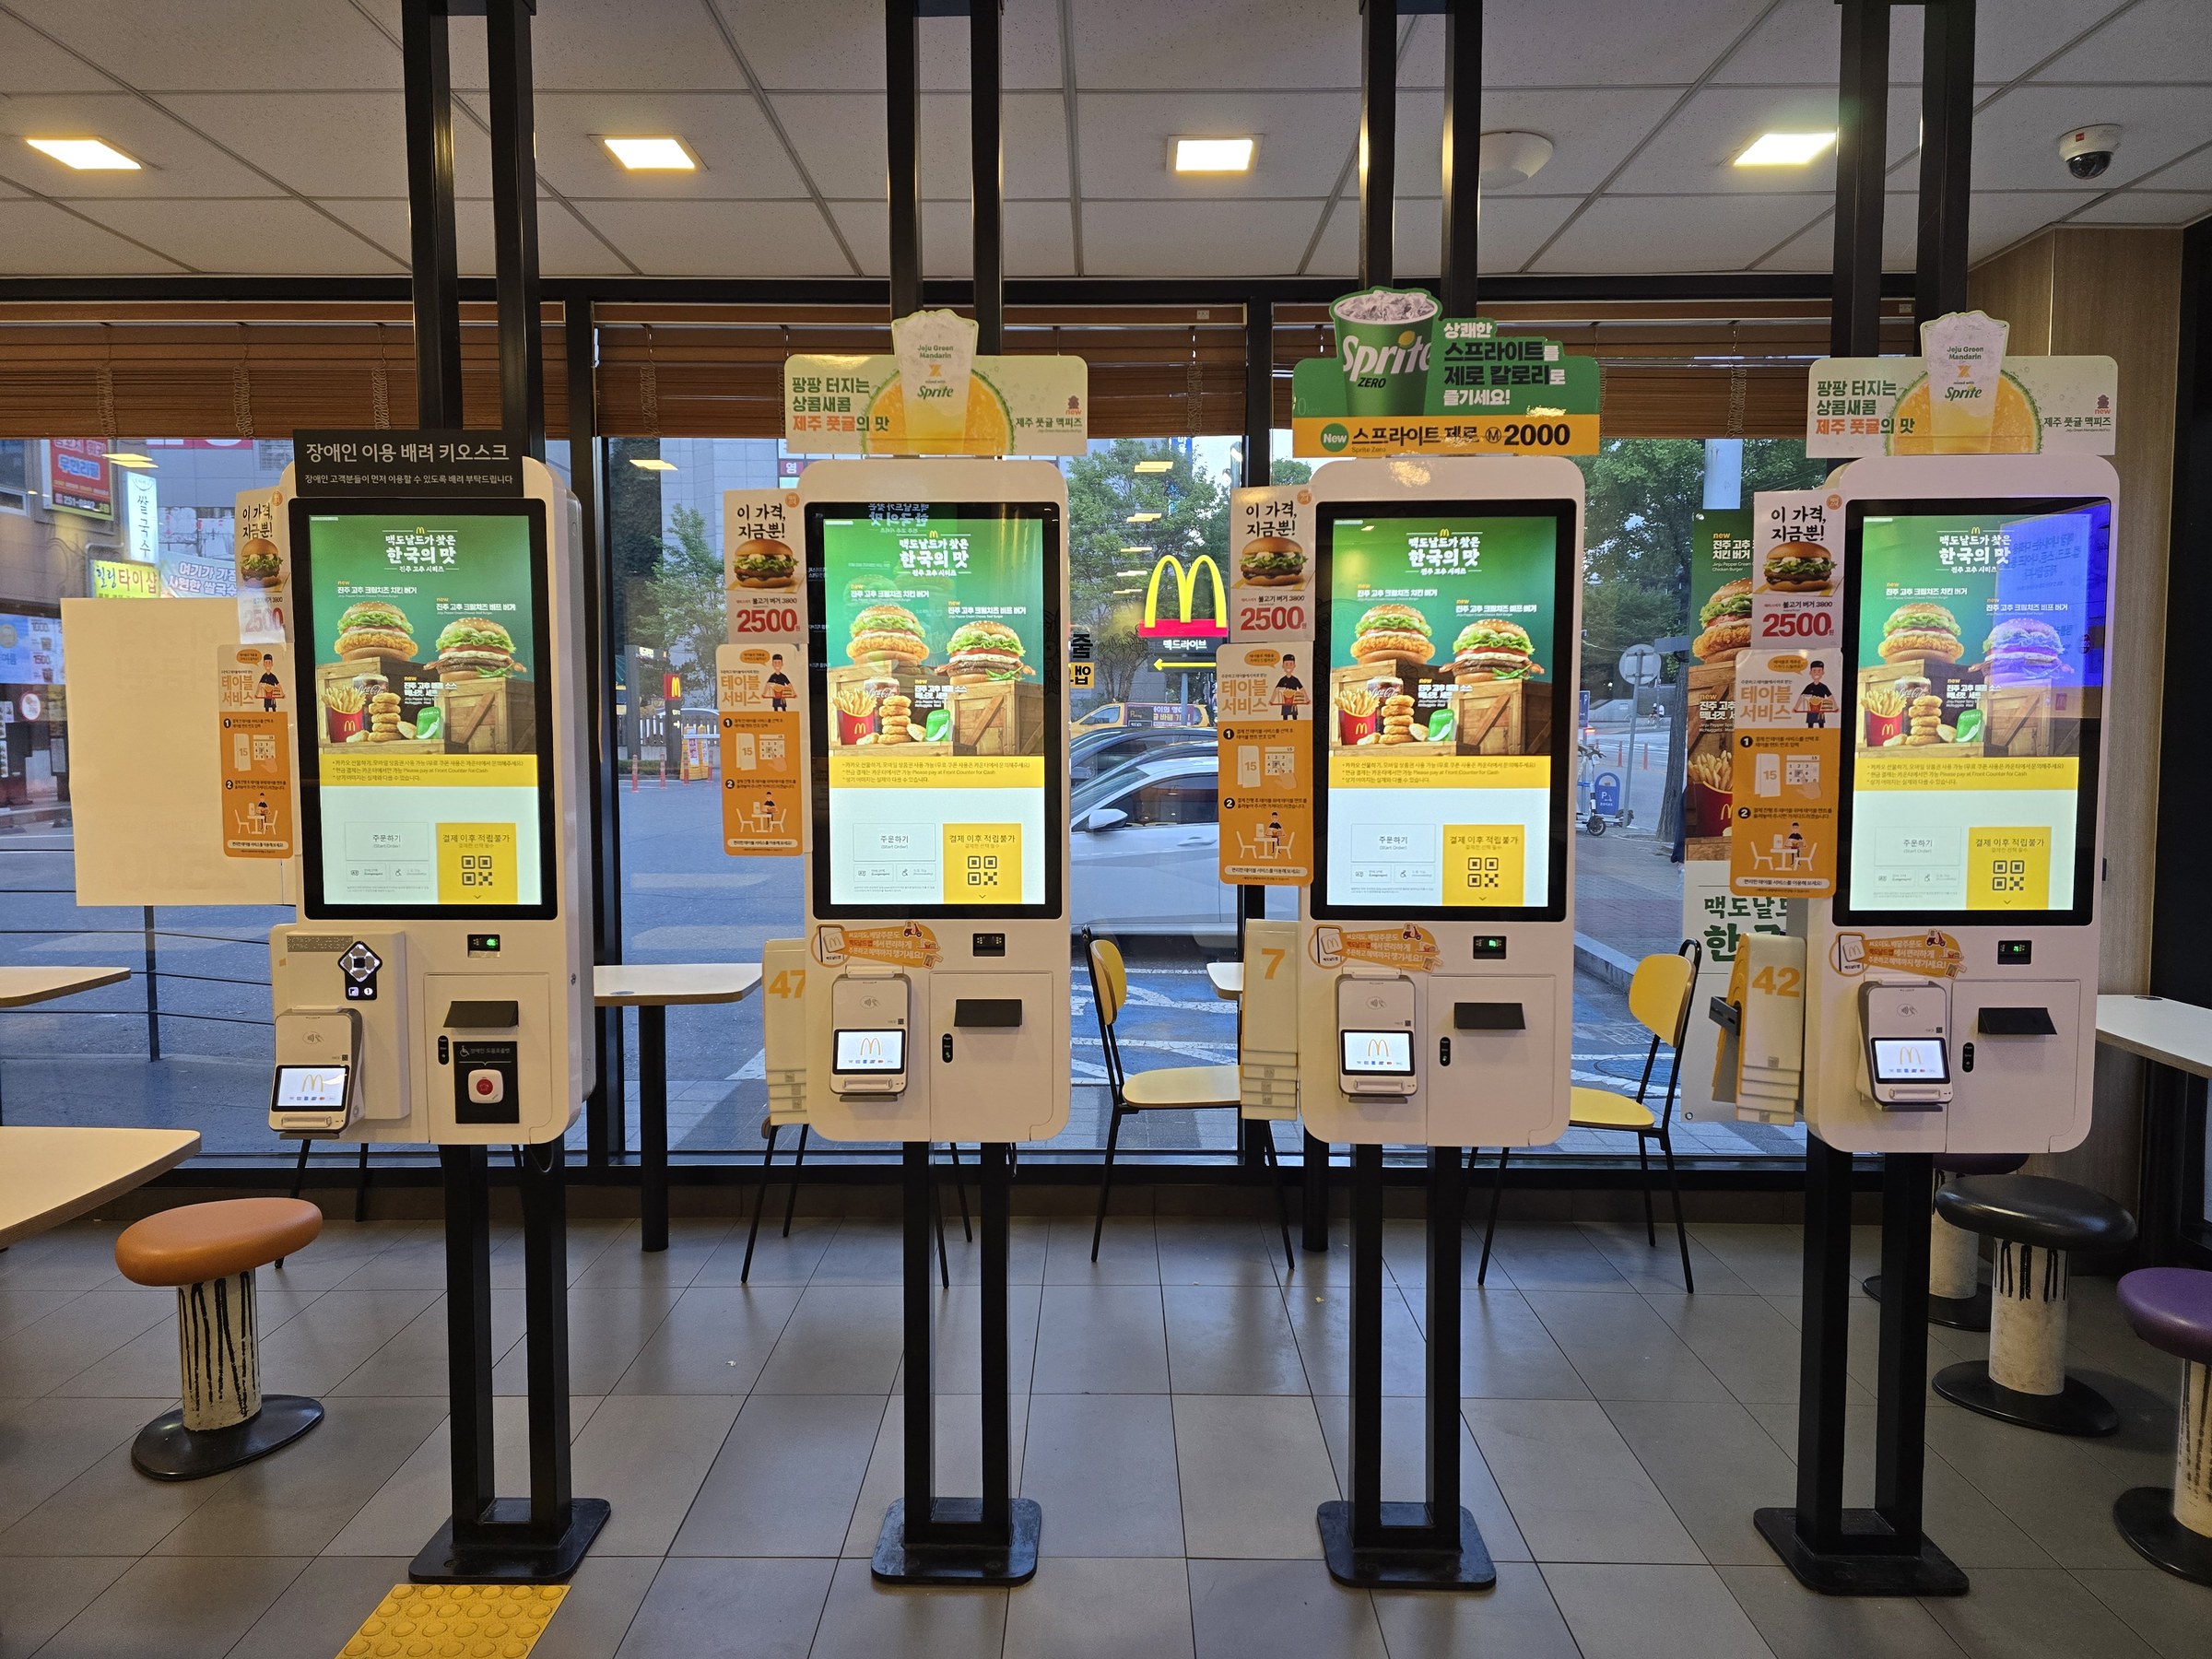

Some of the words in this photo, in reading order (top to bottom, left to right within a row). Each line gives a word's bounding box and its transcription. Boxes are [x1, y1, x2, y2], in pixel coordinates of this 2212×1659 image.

[1443, 323, 1491, 338] 상쾌한
[1343, 335, 1431, 382] Sprite
[1444, 341, 1559, 361] 스프라이트를
[1358, 377, 1386, 388] ZERO
[1444, 365, 1485, 385] 제로
[1490, 365, 1566, 385] 칼로리로
[793, 377, 821, 393] 팡팡
[827, 377, 869, 394] 터지는
[917, 385, 953, 400] Sprite
[1818, 381, 1847, 396] 팡팡
[1852, 381, 1896, 396] 터지는
[1443, 389, 1510, 406] 즐기세요!
[1945, 387, 1982, 401] Sprite
[793, 397, 851, 412] 상콤새콤
[1817, 399, 1876, 415] 상콤새콤
[794, 416, 821, 431] 제주
[827, 416, 869, 431] 풋귤의
[875, 416, 888, 431] 맛
[1016, 418, 1032, 428] 제주
[1036, 418, 1053, 428] 풋귤
[1056, 418, 1082, 427] 맥피즈
[1816, 418, 1845, 434] 제주
[1850, 418, 1894, 434] 풋귤의
[1900, 418, 1914, 434] 맛
[2043, 418, 2061, 427] 제주
[2065, 418, 2082, 427] 풋귤
[2085, 418, 2112, 427] 맥피즈
[1323, 433, 1347, 443] New
[1351, 427, 1440, 446] 스프라이트
[1445, 427, 1479, 443] 제로
[1504, 424, 1570, 446] 2000
[306, 444, 357, 463] 장애인
[362, 444, 396, 463] 이용
[401, 444, 433, 463] 배려
[440, 444, 509, 463] 키오스크
[305, 475, 328, 484] 장애인
[330, 475, 370, 484] 고객분들이
[371, 475, 386, 484] 먼저
[388, 475, 412, 484] 이용할
[414, 475, 421, 484] 수
[424, 475, 446, 484] 있도록
[449, 475, 464, 484] 배려
[465, 475, 512, 484] 부탁드립니다
[242, 505, 250, 521] 이
[737, 504, 749, 521] 이
[756, 503, 785, 521] 가격,
[1246, 502, 1259, 519] 이
[1266, 500, 1297, 519] 가격,
[1771, 507, 1785, 524] 이
[1792, 506, 1826, 524] 가격,
[137, 496, 150, 558] 쌀국수
[242, 522, 272, 540] 지금뿐!
[738, 523, 785, 539] 지금뿐!
[1246, 521, 1295, 537] 지금뿐!
[1771, 525, 1824, 542] 지금뿐!
[385, 535, 434, 546] 맥도날드가
[900, 538, 947, 550] 맥도날드가
[1408, 537, 1458, 548] 맥도날드가
[1713, 540, 1731, 549] 진주
[1733, 540, 1750, 549] 고추
[1939, 535, 1990, 547] 맥도날드가
[386, 547, 436, 564] 한국의
[440, 547, 456, 564] 맛
[900, 550, 948, 568] 한국의
[953, 550, 969, 569] 맛
[1408, 549, 1458, 567] 한국의
[1464, 548, 1480, 567] 맛
[1712, 550, 1731, 559] 치킨
[1733, 550, 1750, 559] 버거
[1939, 547, 1990, 565] 한국의
[1994, 547, 2011, 564] 맛
[180, 563, 214, 579] 여기가
[96, 566, 116, 588] 힐링
[119, 569, 157, 594] 타이샵
[169, 575, 201, 593] 시원한
[204, 582, 237, 597] 쌀국수
[1163, 640, 1207, 650] 맥드라이브
[222, 676, 253, 690] 테이블
[722, 675, 760, 690] 테이블
[1070, 665, 1091, 686] 앱
[1221, 679, 1268, 697] 테이블
[1741, 686, 1793, 703] 테이블
[222, 691, 254, 706] 서비스
[722, 691, 761, 706] 서비스
[1700, 701, 1717, 710] 진주
[1222, 698, 1268, 715] 서비스
[1740, 704, 1792, 723] 서비스
[742, 747, 753, 756] 15
[1245, 762, 1257, 771] 15
[1763, 771, 1777, 780] 15
[372, 834, 401, 842] 주문하기
[442, 834, 459, 843] 결제
[461, 834, 476, 843] 이후
[477, 834, 511, 843] 적립불가
[881, 835, 909, 843] 주문하기
[949, 835, 964, 843] 결제
[967, 835, 982, 843] 이후
[984, 835, 1015, 843] 적립불가
[1379, 836, 1408, 844] 주문하기
[1450, 836, 1465, 845] 결제
[1468, 836, 1483, 844] 이후
[1486, 836, 1518, 844] 적립불가
[1903, 839, 1933, 848] 주문하기
[1975, 839, 1992, 847] 결제
[1993, 839, 2009, 847] 이후
[2012, 838, 2044, 847] 적립불가
[1262, 948, 1285, 980] 7
[768, 970, 806, 999] 47
[1752, 966, 1800, 998] 42
